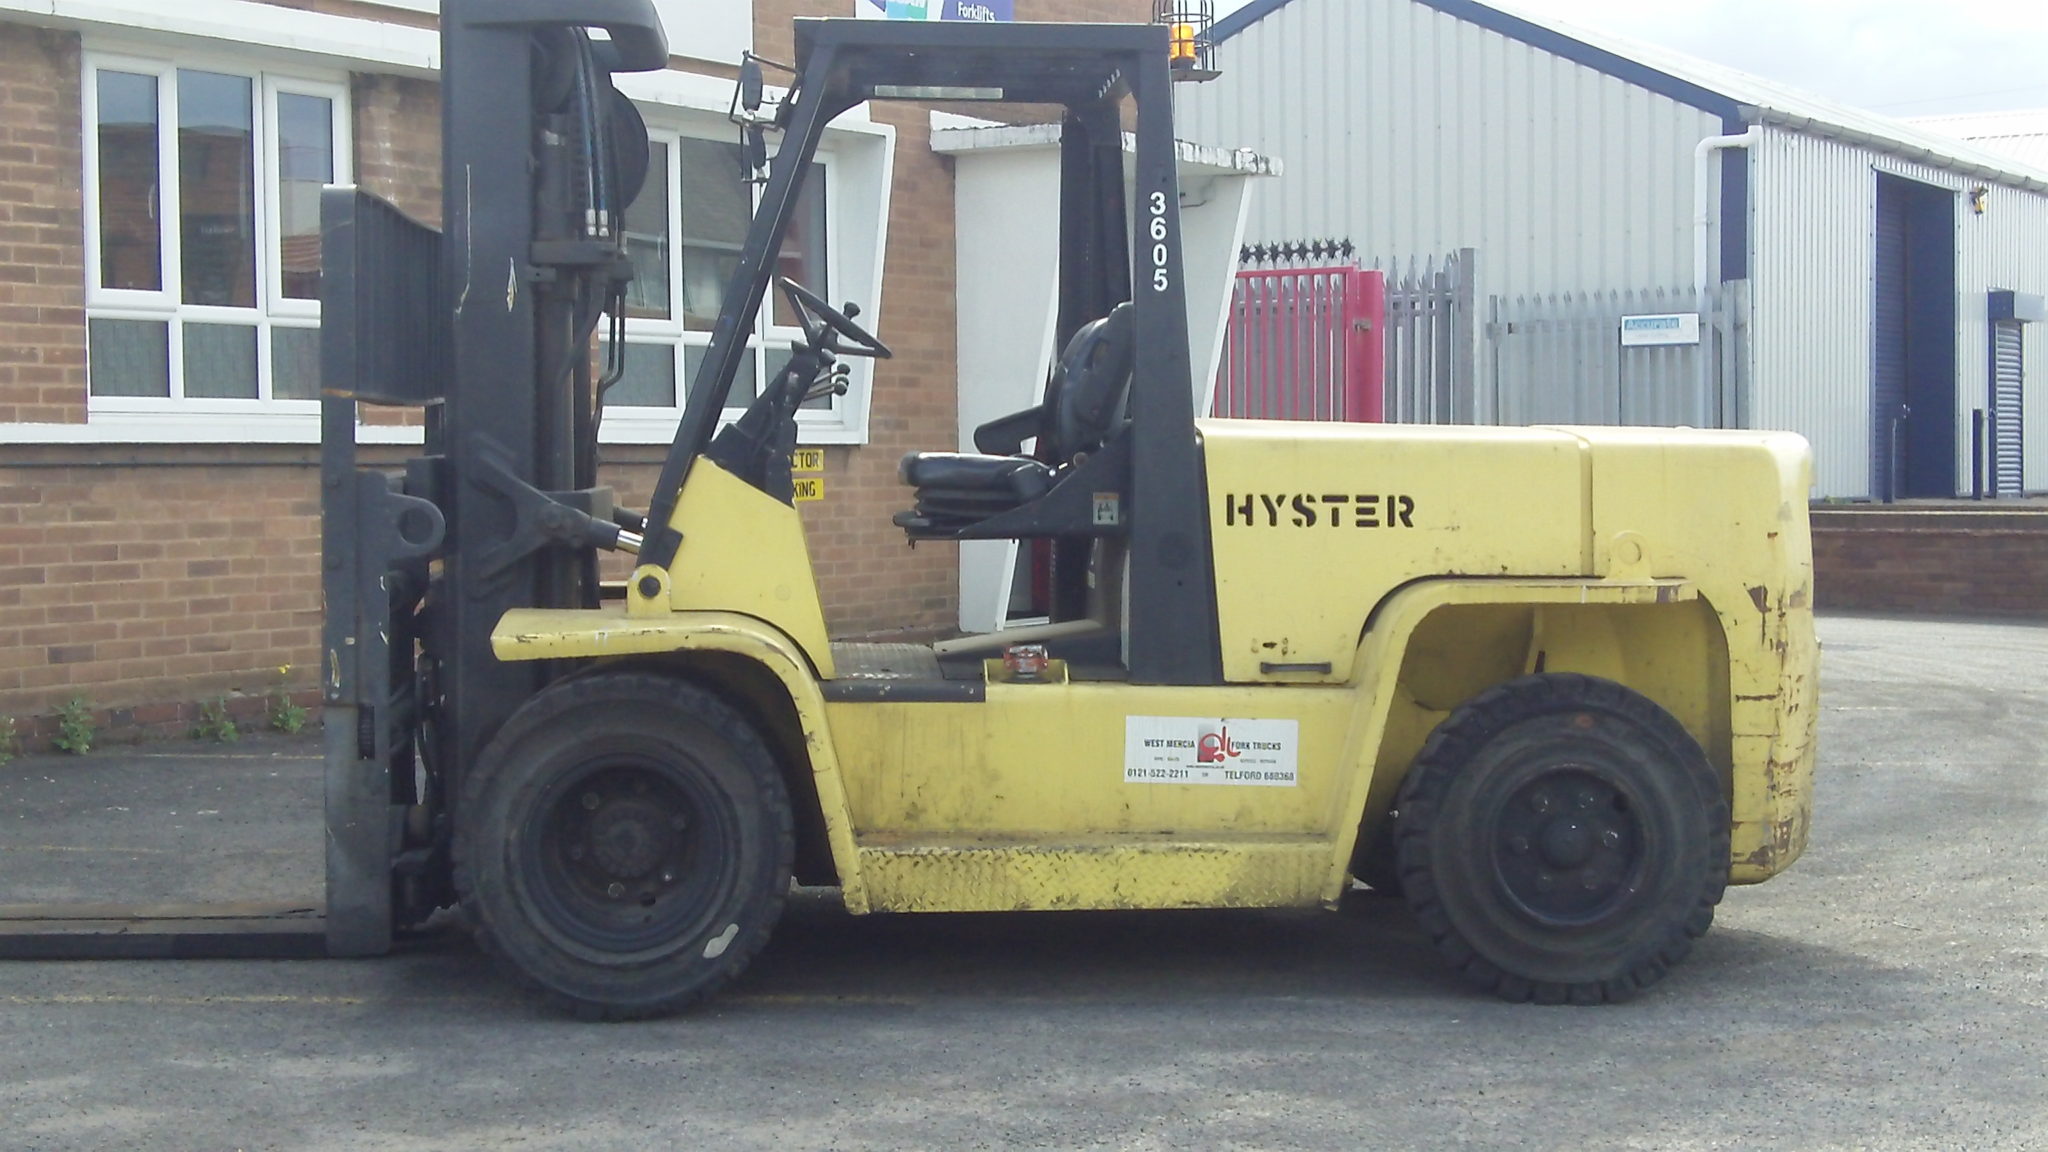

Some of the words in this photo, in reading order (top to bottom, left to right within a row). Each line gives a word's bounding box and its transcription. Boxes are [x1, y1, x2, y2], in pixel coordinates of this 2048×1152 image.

[957, 1, 996, 23] Forklifts
[1149, 191, 1168, 292] 3605
[791, 452, 819, 468] CTOR
[793, 481, 816, 498] KING
[1226, 493, 1415, 528] HYSTER
[1144, 738, 1164, 748] WEST
[1166, 739, 1196, 749] MERCIA
[1231, 741, 1251, 751] FORK
[1253, 741, 1282, 751] TRUCKS
[1225, 770, 1262, 780] TELFORD
